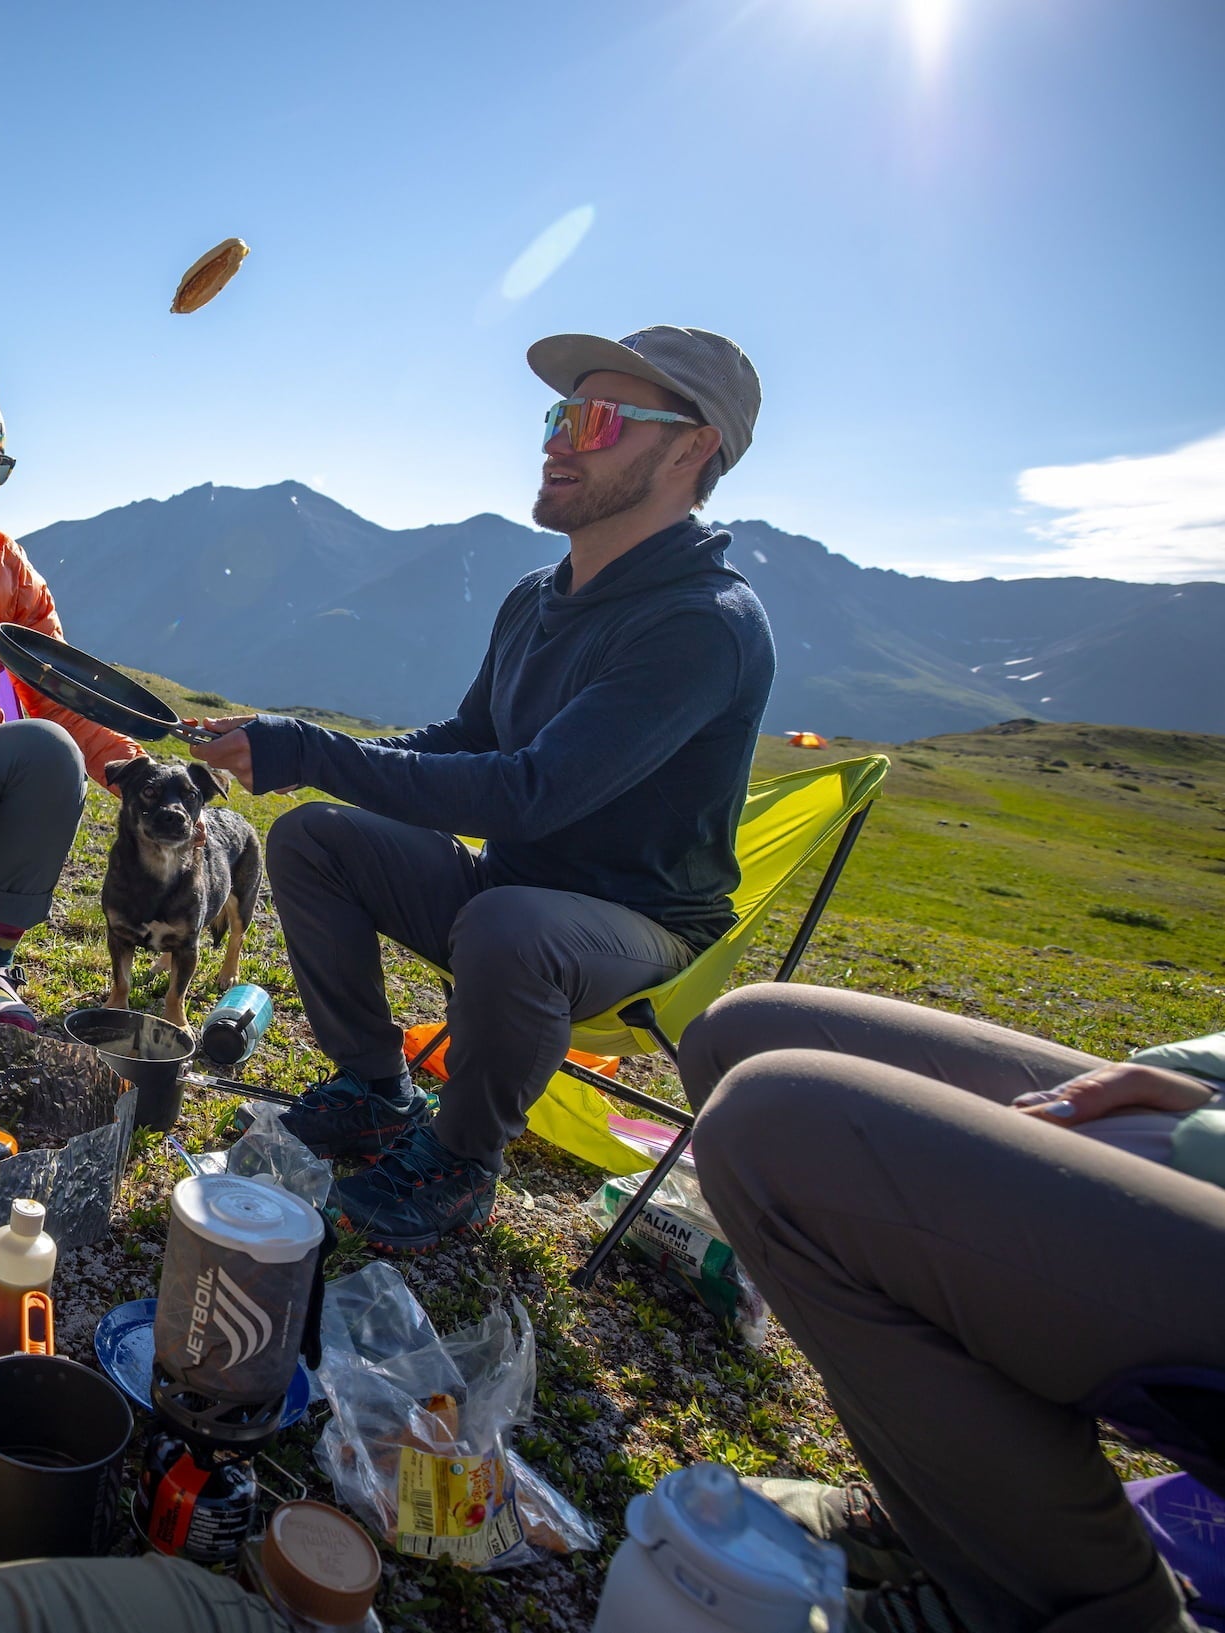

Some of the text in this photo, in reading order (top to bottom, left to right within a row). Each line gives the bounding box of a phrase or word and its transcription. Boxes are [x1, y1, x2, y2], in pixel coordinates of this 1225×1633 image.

[639, 1209, 692, 1243] TALIAN
[658, 1233, 688, 1252] BLEND
[186, 1268, 214, 1365] JETBOIL
[468, 1469, 482, 1502] Mango
[490, 1537, 502, 1555] 120
